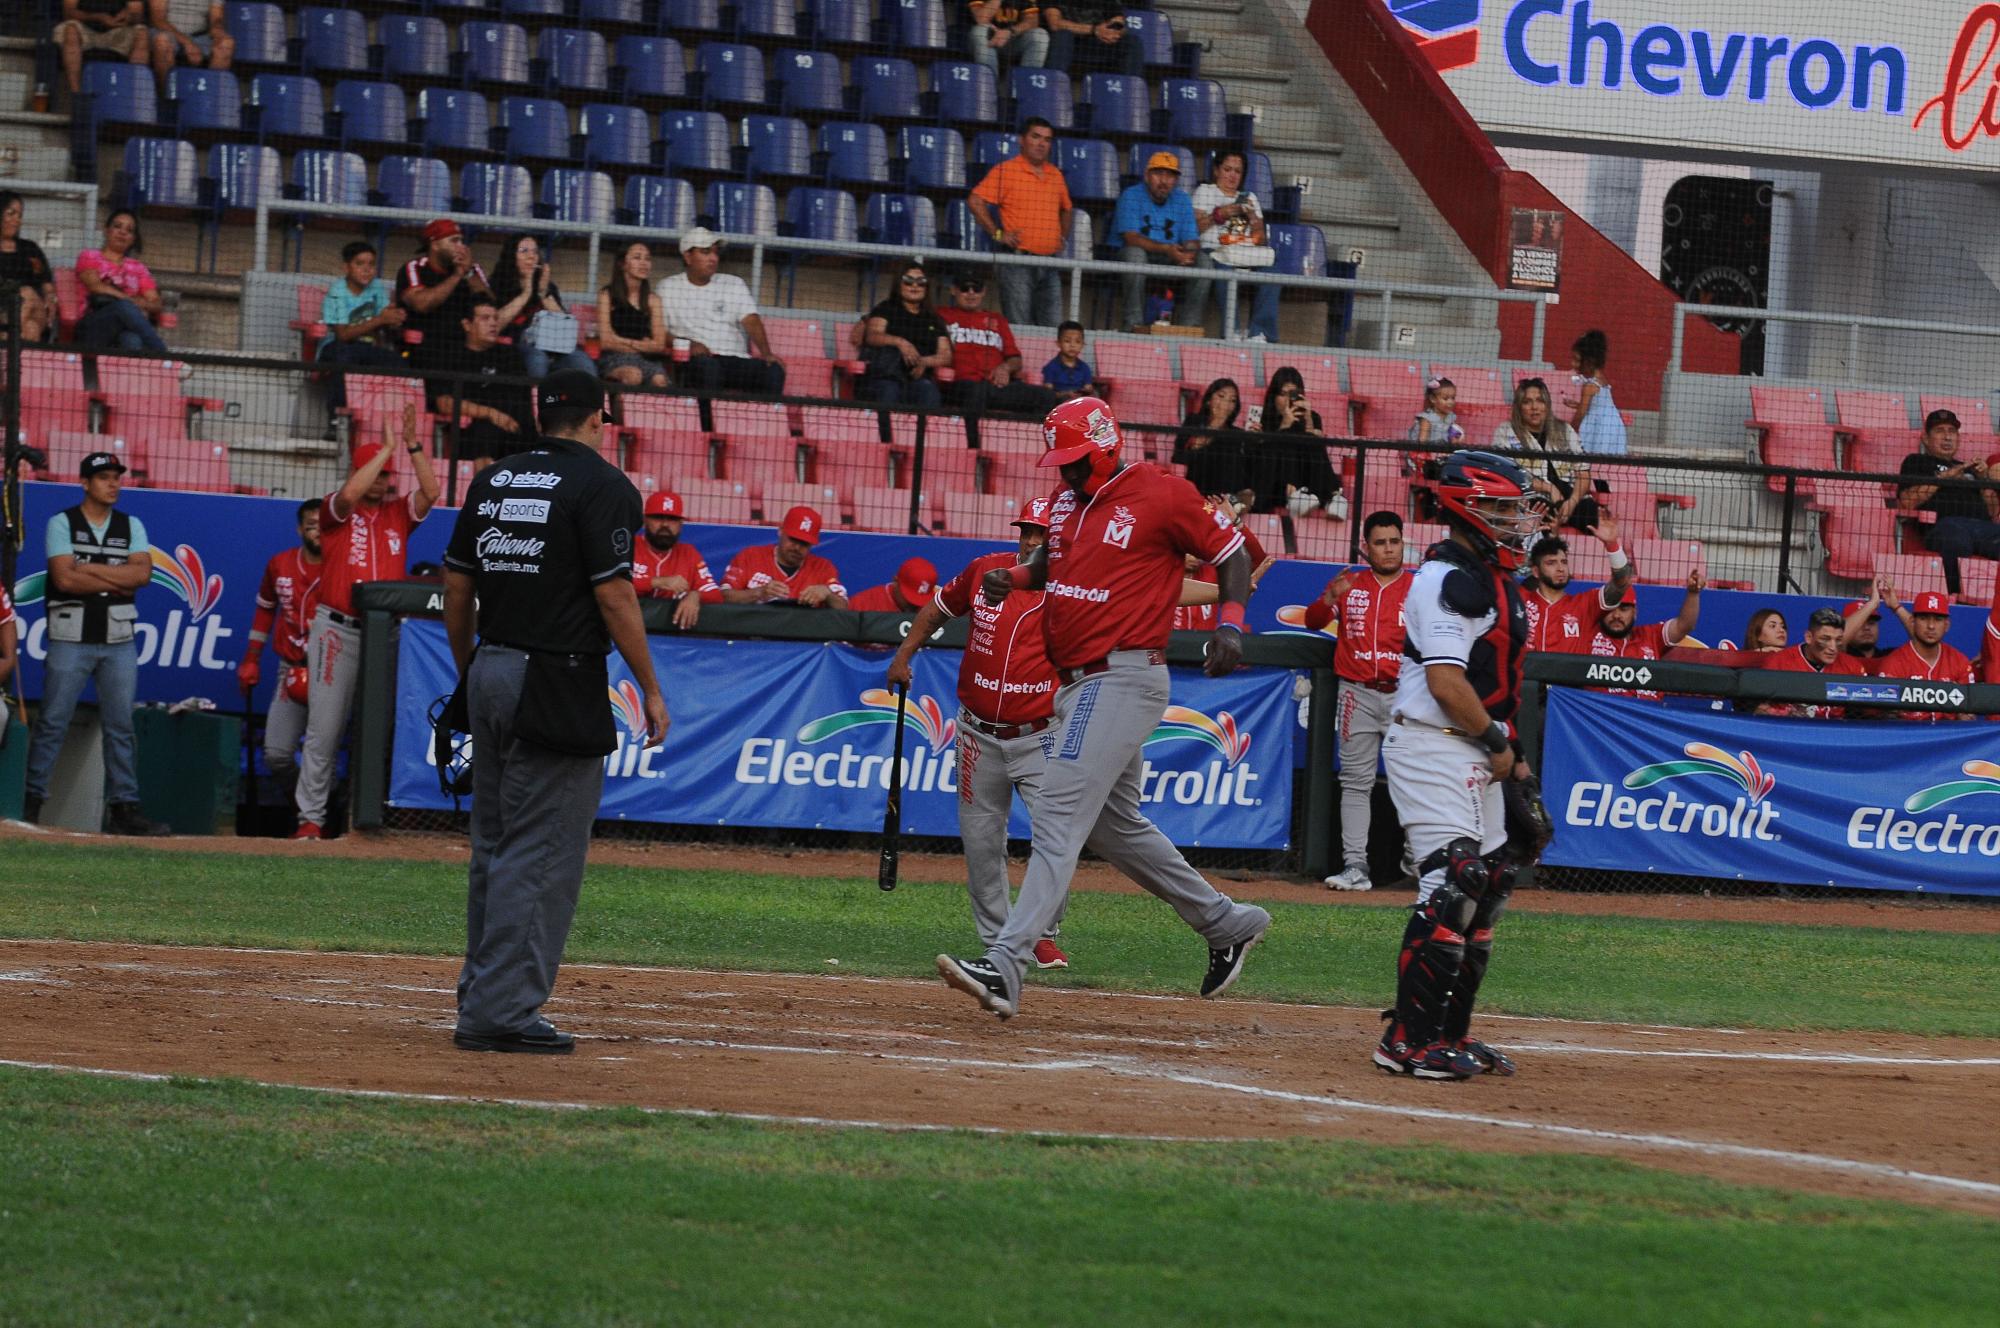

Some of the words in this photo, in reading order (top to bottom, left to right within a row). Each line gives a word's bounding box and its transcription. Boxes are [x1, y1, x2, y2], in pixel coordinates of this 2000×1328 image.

[323, 12, 334, 26] 4
[1126, 16, 1143, 30] 15
[406, 21, 417, 34] 5
[485, 29, 497, 42] 6
[564, 34, 576, 48] 7
[722, 50, 734, 63] 9
[795, 54, 813, 69] 10
[1503, 0, 1908, 115] Chevron
[874, 63, 890, 77] 11
[952, 67, 970, 81] 12
[197, 78, 207, 91] 2
[1030, 74, 1048, 89] 13
[1106, 79, 1123, 94] 14
[1179, 86, 1198, 101] 15
[1512, 263, 1557, 276] ALCOHOL
[477, 500, 500, 519] sky
[503, 504, 545, 519] sports
[476, 526, 545, 558] Caliente
[611, 528, 632, 556] 9
[1103, 520, 1133, 550] M
[489, 560, 540, 574] caliente.mx
[974, 594, 1004, 613] Moil
[1563, 622, 1580, 638] M
[1586, 664, 1635, 683] ARCO
[974, 672, 1000, 691] Red
[1901, 687, 1948, 705] ARCO
[735, 738, 958, 794] Electrolit
[1139, 761, 1259, 806] trolit
[1565, 782, 1781, 842] Electrolit
